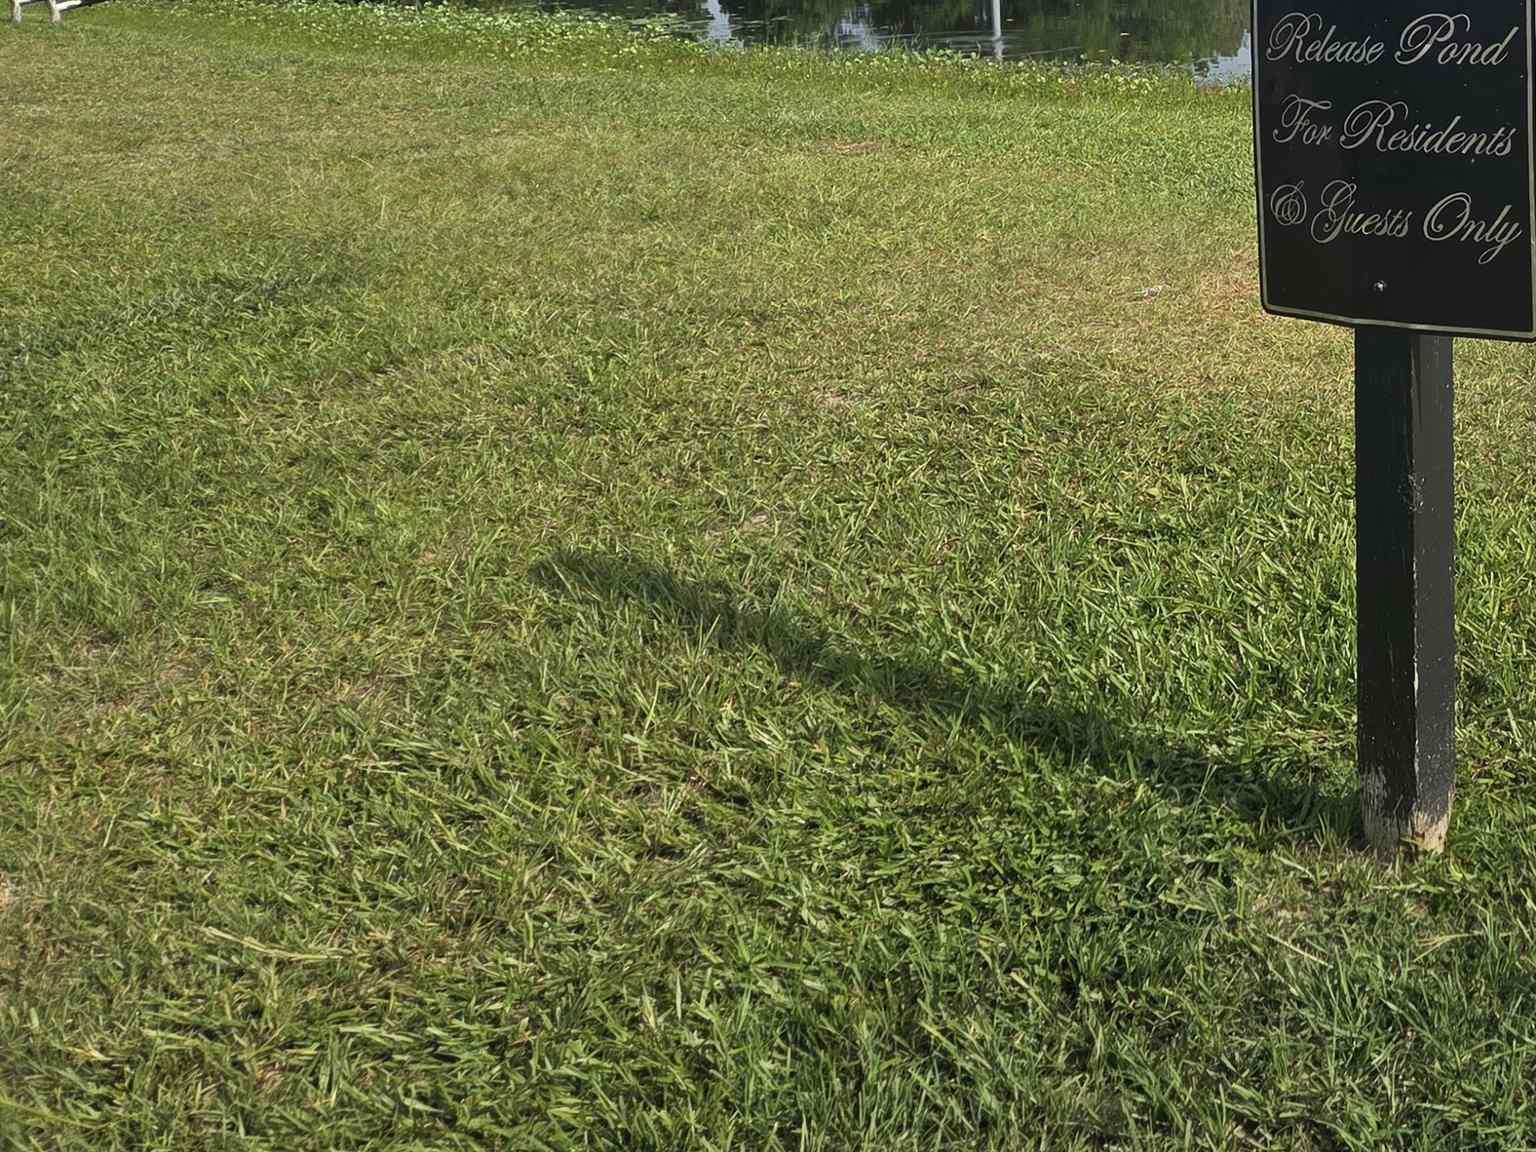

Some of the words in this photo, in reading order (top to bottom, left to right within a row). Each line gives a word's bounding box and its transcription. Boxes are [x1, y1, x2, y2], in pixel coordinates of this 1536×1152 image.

[1266, 12, 1384, 65] Release
[1394, 13, 1519, 66] Pond
[1272, 94, 1333, 145] For
[1340, 100, 1517, 156] Residents
[1271, 180, 1307, 225] &
[1311, 179, 1412, 243] Guests
[1423, 191, 1522, 265] Only
